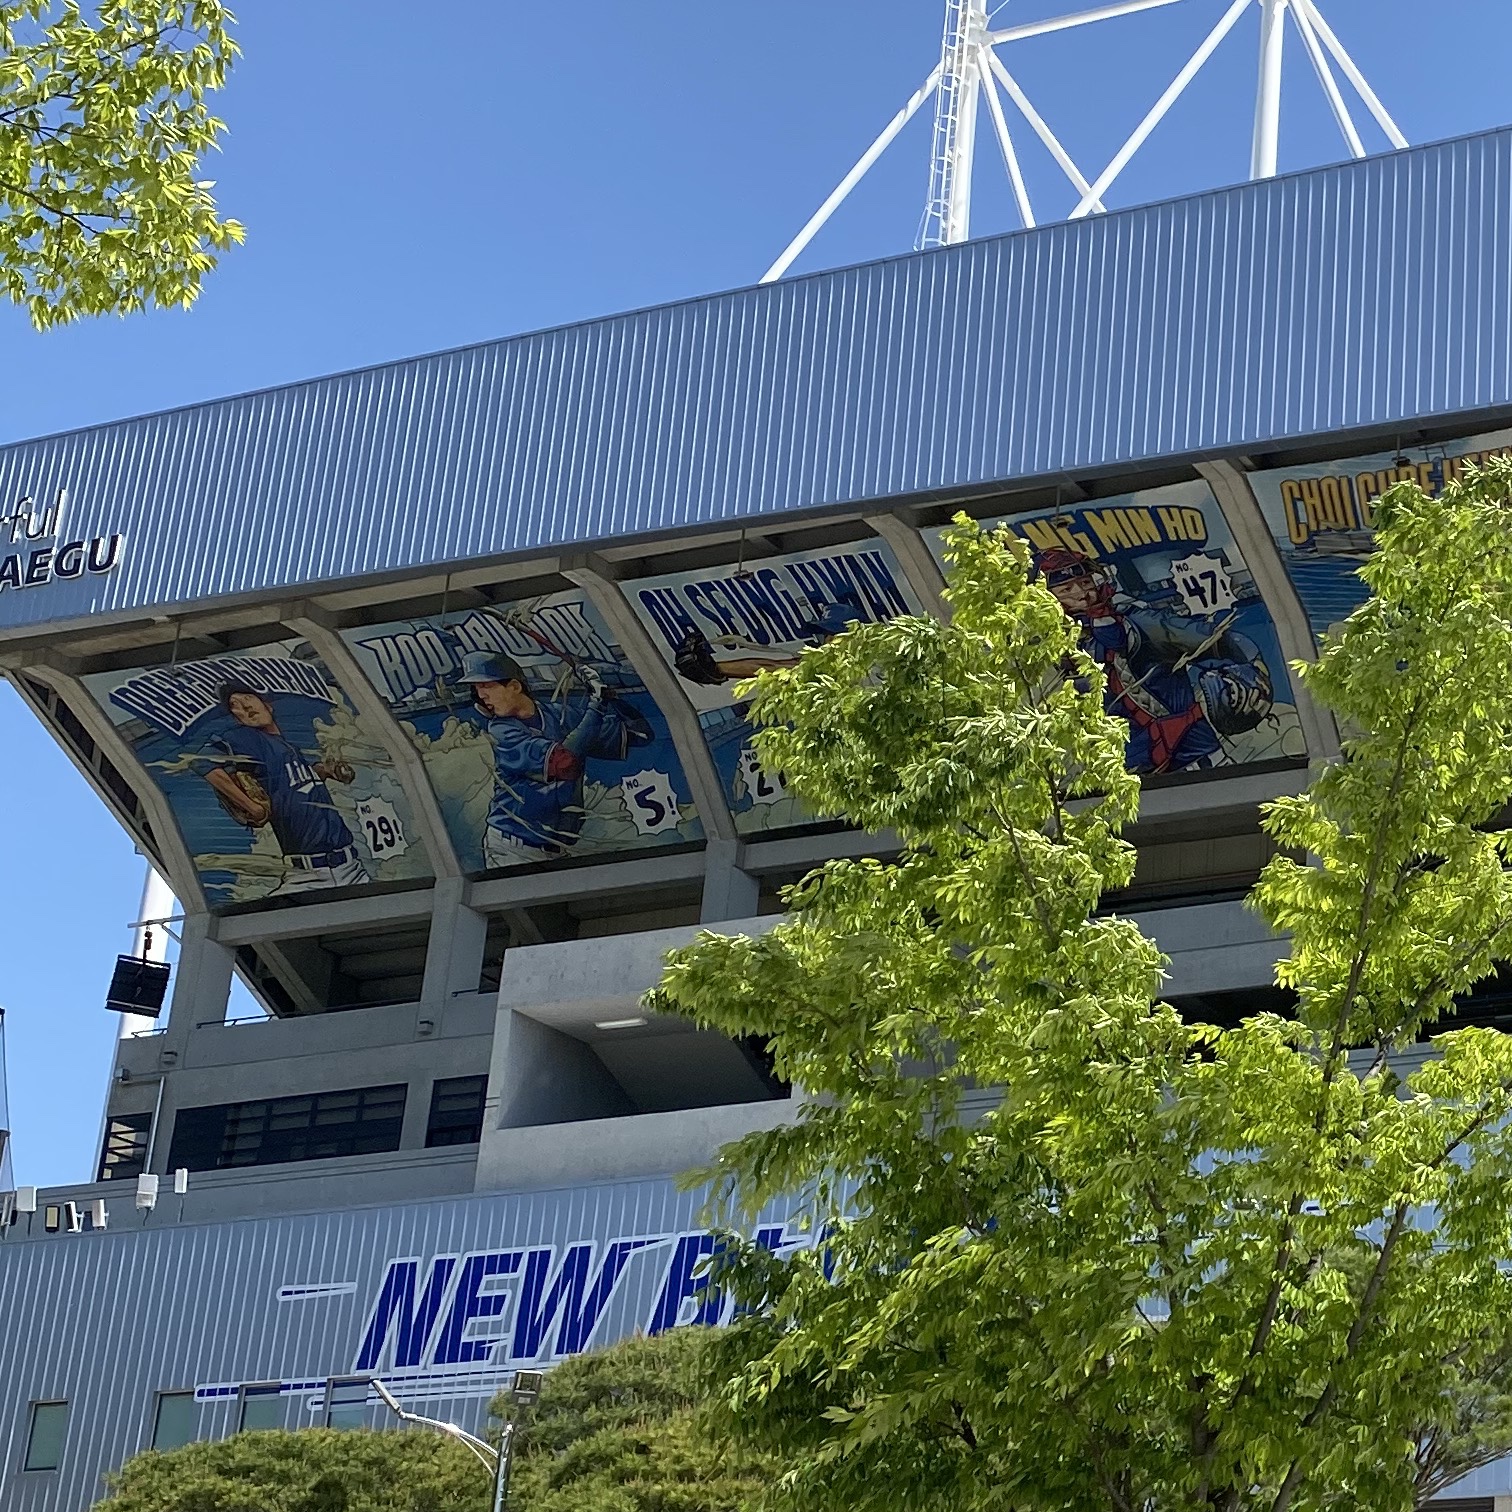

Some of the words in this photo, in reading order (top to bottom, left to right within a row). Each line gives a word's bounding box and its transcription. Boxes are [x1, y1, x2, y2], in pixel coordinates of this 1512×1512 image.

[0, 488, 69, 544] ful
[1082, 505, 1162, 554] MIN
[1157, 505, 1208, 542] HO
[1280, 474, 1358, 546] CHOI
[638, 586, 716, 655] OH
[682, 566, 804, 647] SEUNG
[1181, 570, 1231, 608] 47!
[350, 628, 453, 702] KOO
[634, 784, 677, 827] 5!
[366, 816, 403, 853] 29!
[353, 1232, 668, 1372] NEW
